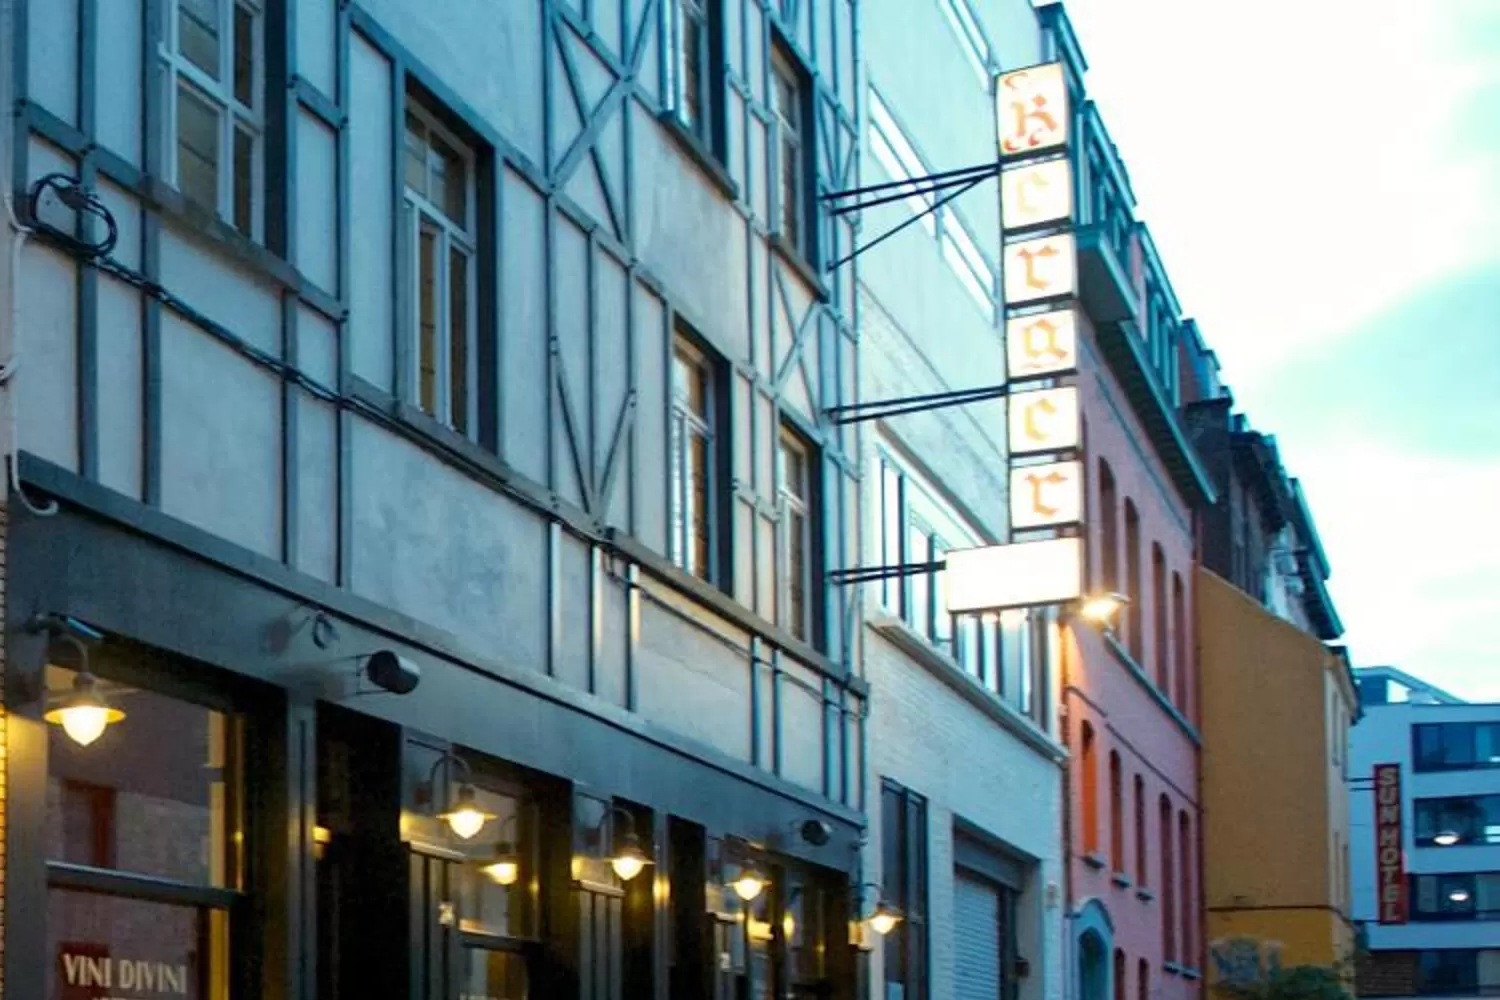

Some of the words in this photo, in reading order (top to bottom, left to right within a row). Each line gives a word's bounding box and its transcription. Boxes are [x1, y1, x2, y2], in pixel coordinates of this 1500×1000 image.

[1378, 767, 1399, 824] SUN
[1379, 827, 1402, 922] HOTEL
[63, 953, 112, 988] VINI
[119, 959, 187, 994] DIVINI
